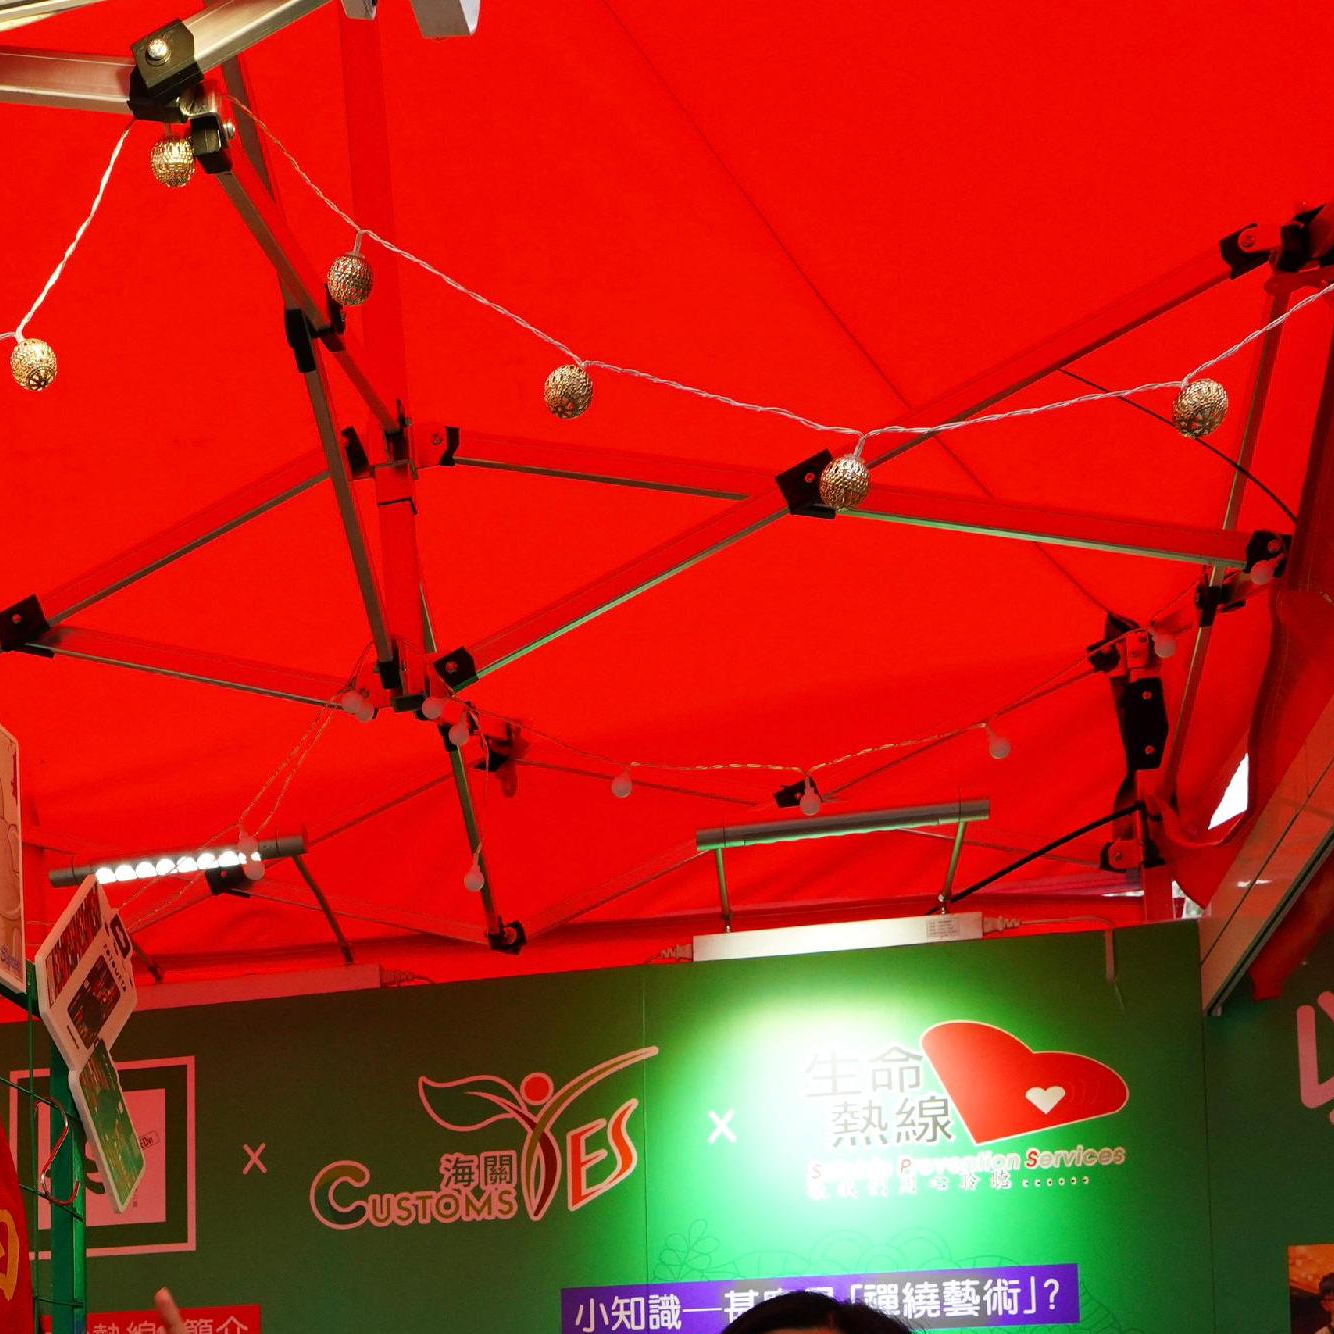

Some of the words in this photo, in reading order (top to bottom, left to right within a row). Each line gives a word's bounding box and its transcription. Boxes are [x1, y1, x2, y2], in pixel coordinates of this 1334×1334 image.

[804, 1046, 924, 1099] 生命
[831, 1095, 954, 1149] 熱線
[440, 1151, 518, 1187] 海關
[1024, 1144, 1127, 1172] Services
